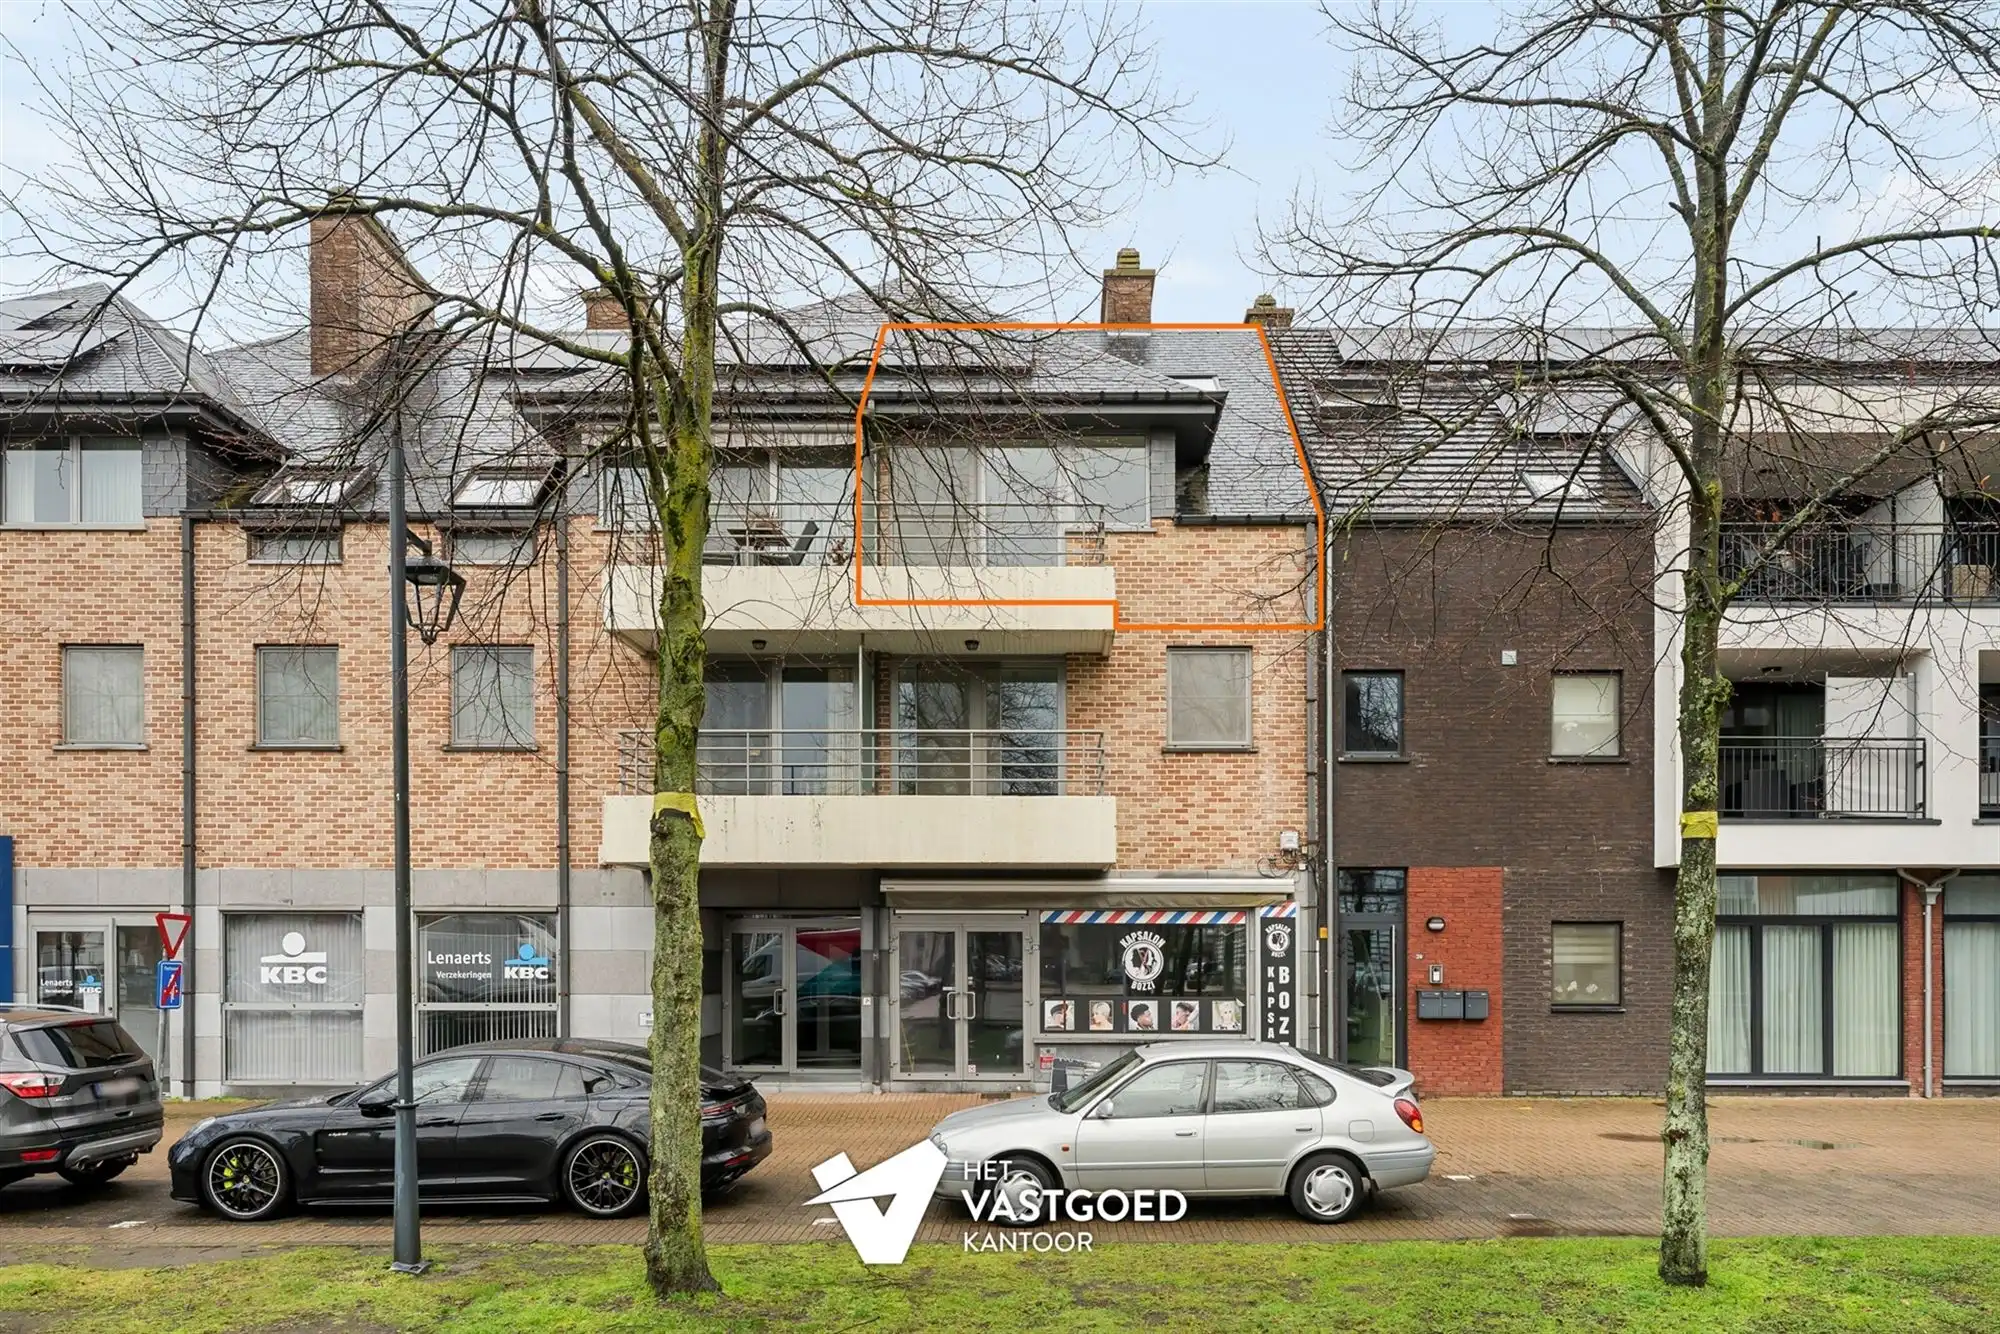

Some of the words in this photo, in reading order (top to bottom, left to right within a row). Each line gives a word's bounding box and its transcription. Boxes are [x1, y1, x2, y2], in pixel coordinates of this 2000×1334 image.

[1265, 924, 1291, 934] KAPSALON
[1120, 931, 1166, 948] KAPSALON
[428, 951, 492, 964] Lenaerts
[260, 967, 327, 984] KBC
[436, 971, 492, 980] Verzekeringen
[504, 967, 548, 979] KBC
[1131, 981, 1156, 991] BOZZI
[1279, 966, 1290, 1046] BOZ
